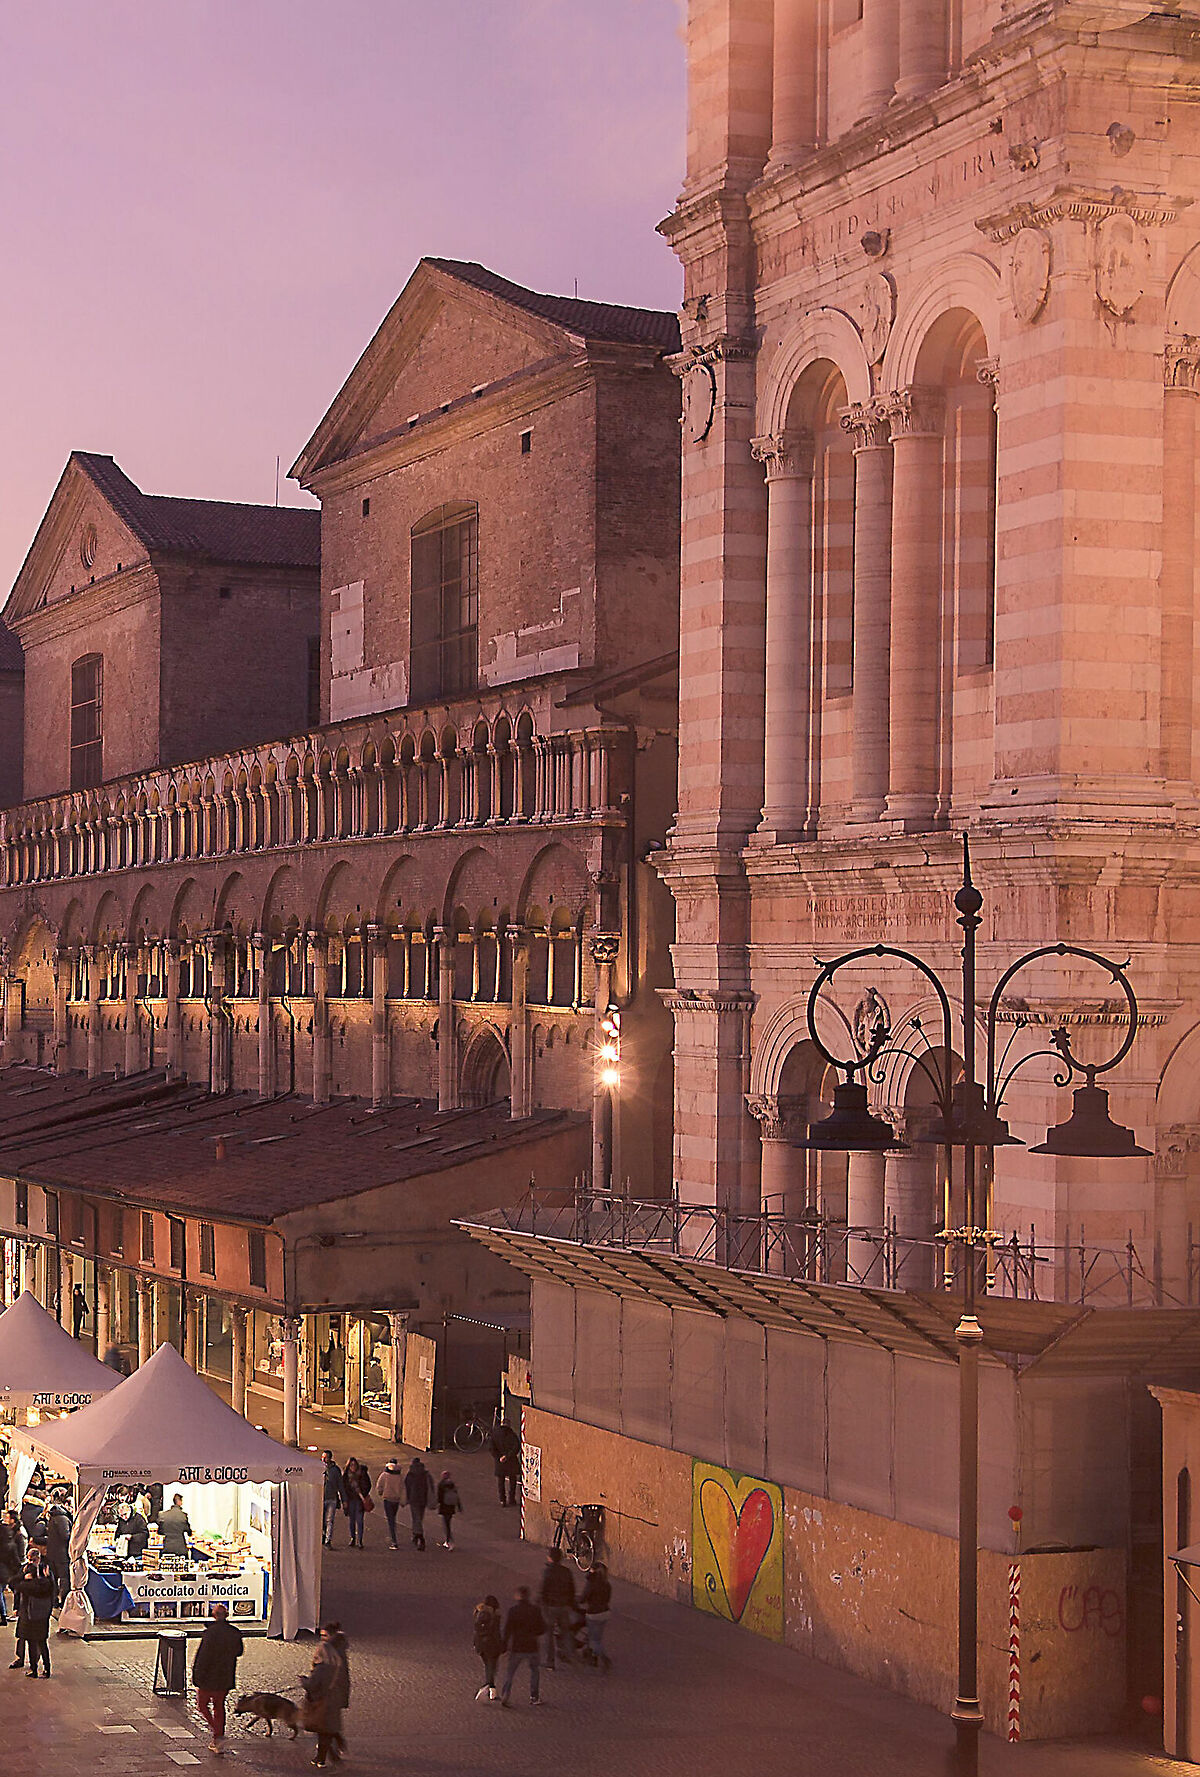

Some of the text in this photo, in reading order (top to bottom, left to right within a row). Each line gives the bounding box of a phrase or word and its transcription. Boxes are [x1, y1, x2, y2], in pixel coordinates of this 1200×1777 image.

[33, 1392, 54, 1405] ART
[54, 1394, 61, 1405] &
[178, 1466, 204, 1481] ART
[204, 1467, 212, 1480] &
[137, 1583, 249, 1598] Cioccolato di Modica
